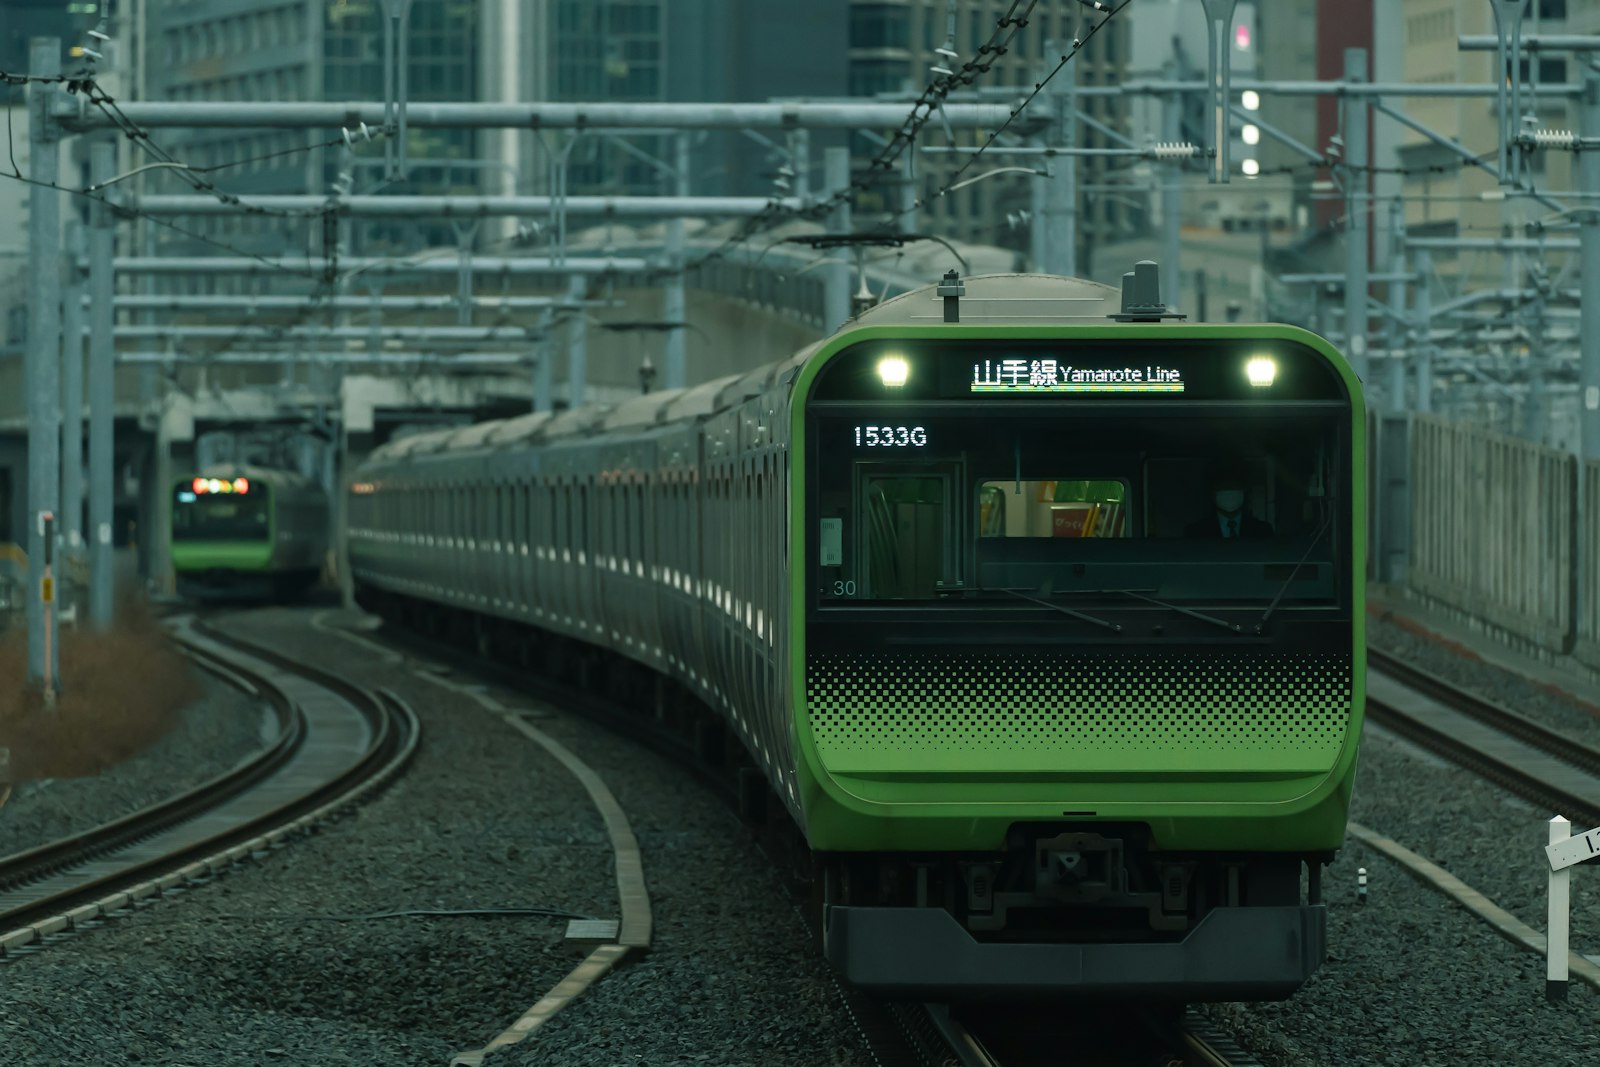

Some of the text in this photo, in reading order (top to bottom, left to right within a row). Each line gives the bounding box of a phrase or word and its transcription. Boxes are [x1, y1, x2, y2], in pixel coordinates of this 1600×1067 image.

[974, 360, 1180, 387] 山手線 Yamanote Line
[855, 426, 927, 446] 1533G
[833, 580, 856, 596] 30
